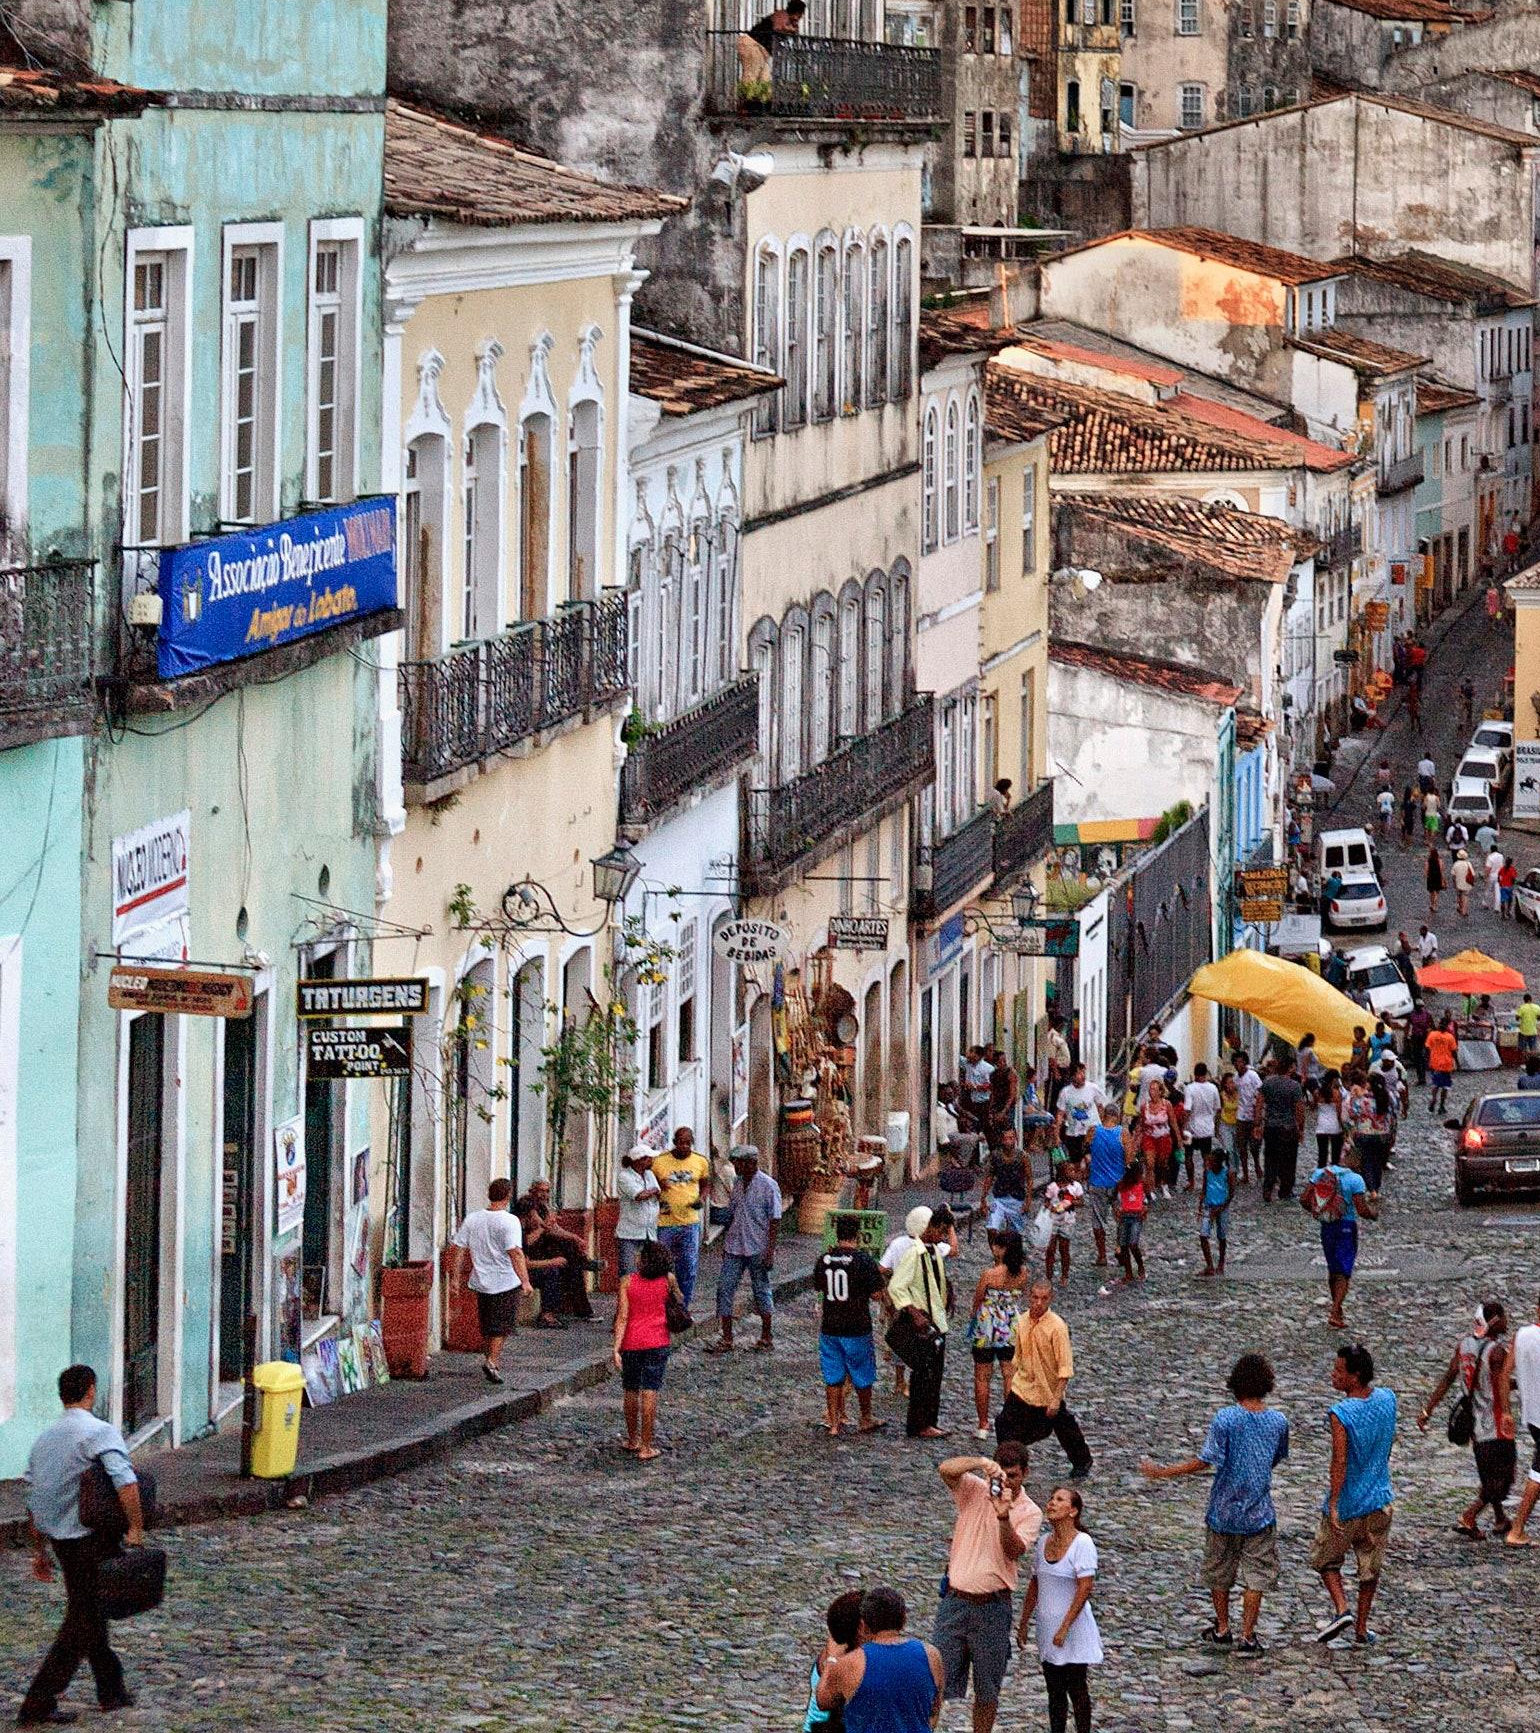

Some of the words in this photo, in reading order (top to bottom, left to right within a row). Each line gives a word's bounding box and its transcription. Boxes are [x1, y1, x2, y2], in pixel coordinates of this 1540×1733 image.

[741, 936, 758, 948] DE
[726, 946, 777, 962] BEBIDAS
[301, 984, 422, 1010] TATUAGENS
[311, 1030, 367, 1044] CUSTOM
[311, 1044, 381, 1061] TATTOO
[346, 1060, 380, 1071] POINT
[824, 1268, 849, 1302] 10
